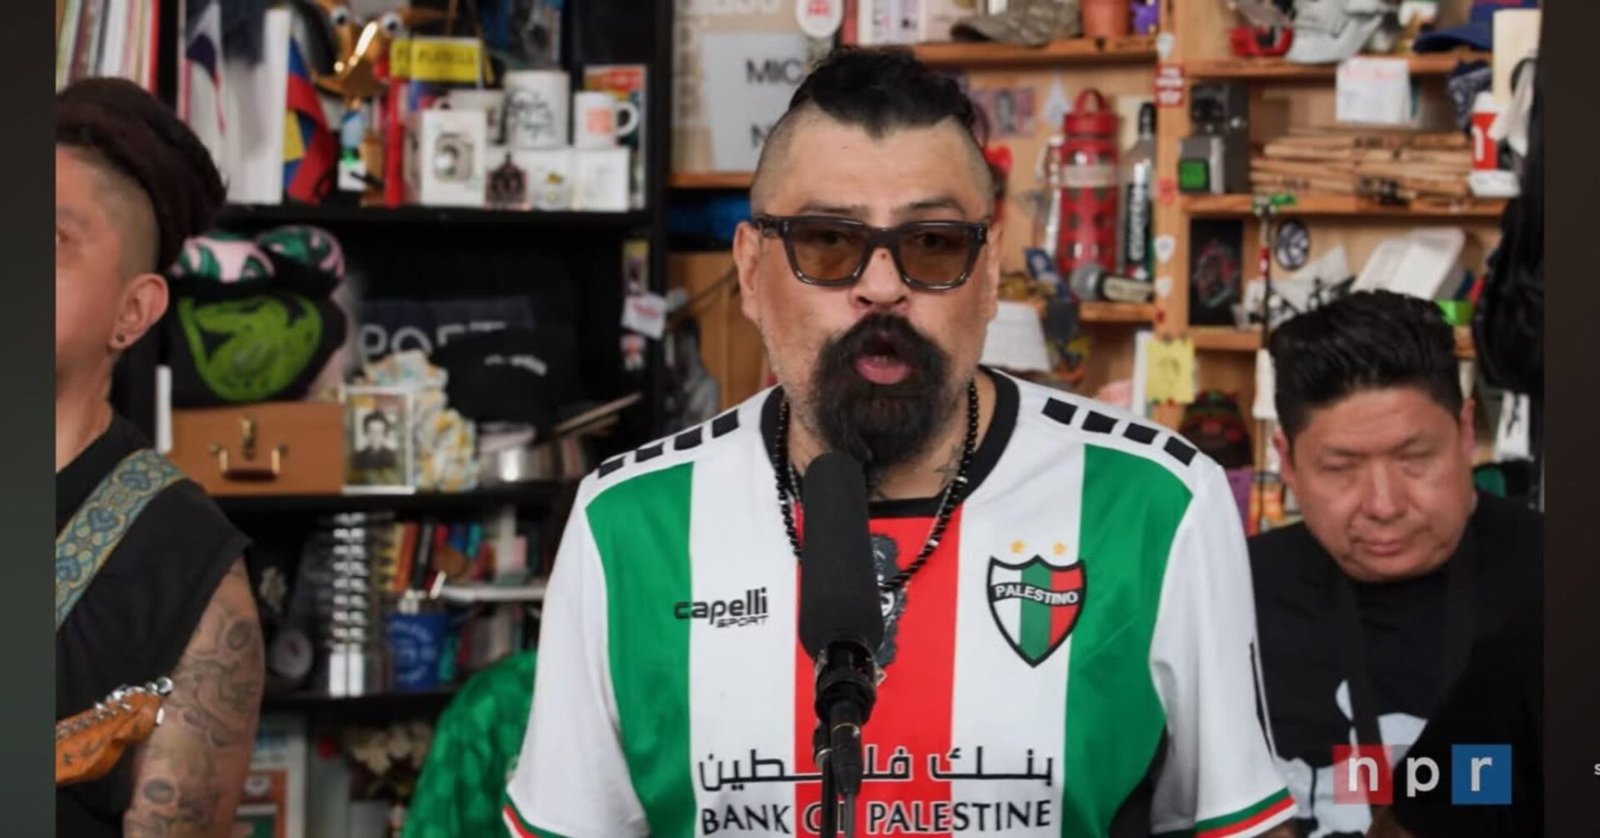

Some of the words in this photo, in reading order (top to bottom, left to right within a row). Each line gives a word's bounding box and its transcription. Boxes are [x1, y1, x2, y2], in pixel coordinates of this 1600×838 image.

[673, 586, 768, 625] capelli
[994, 584, 1079, 605] PALESTINO
[702, 803, 793, 836] BANK
[867, 800, 1052, 834] PALESTINE
